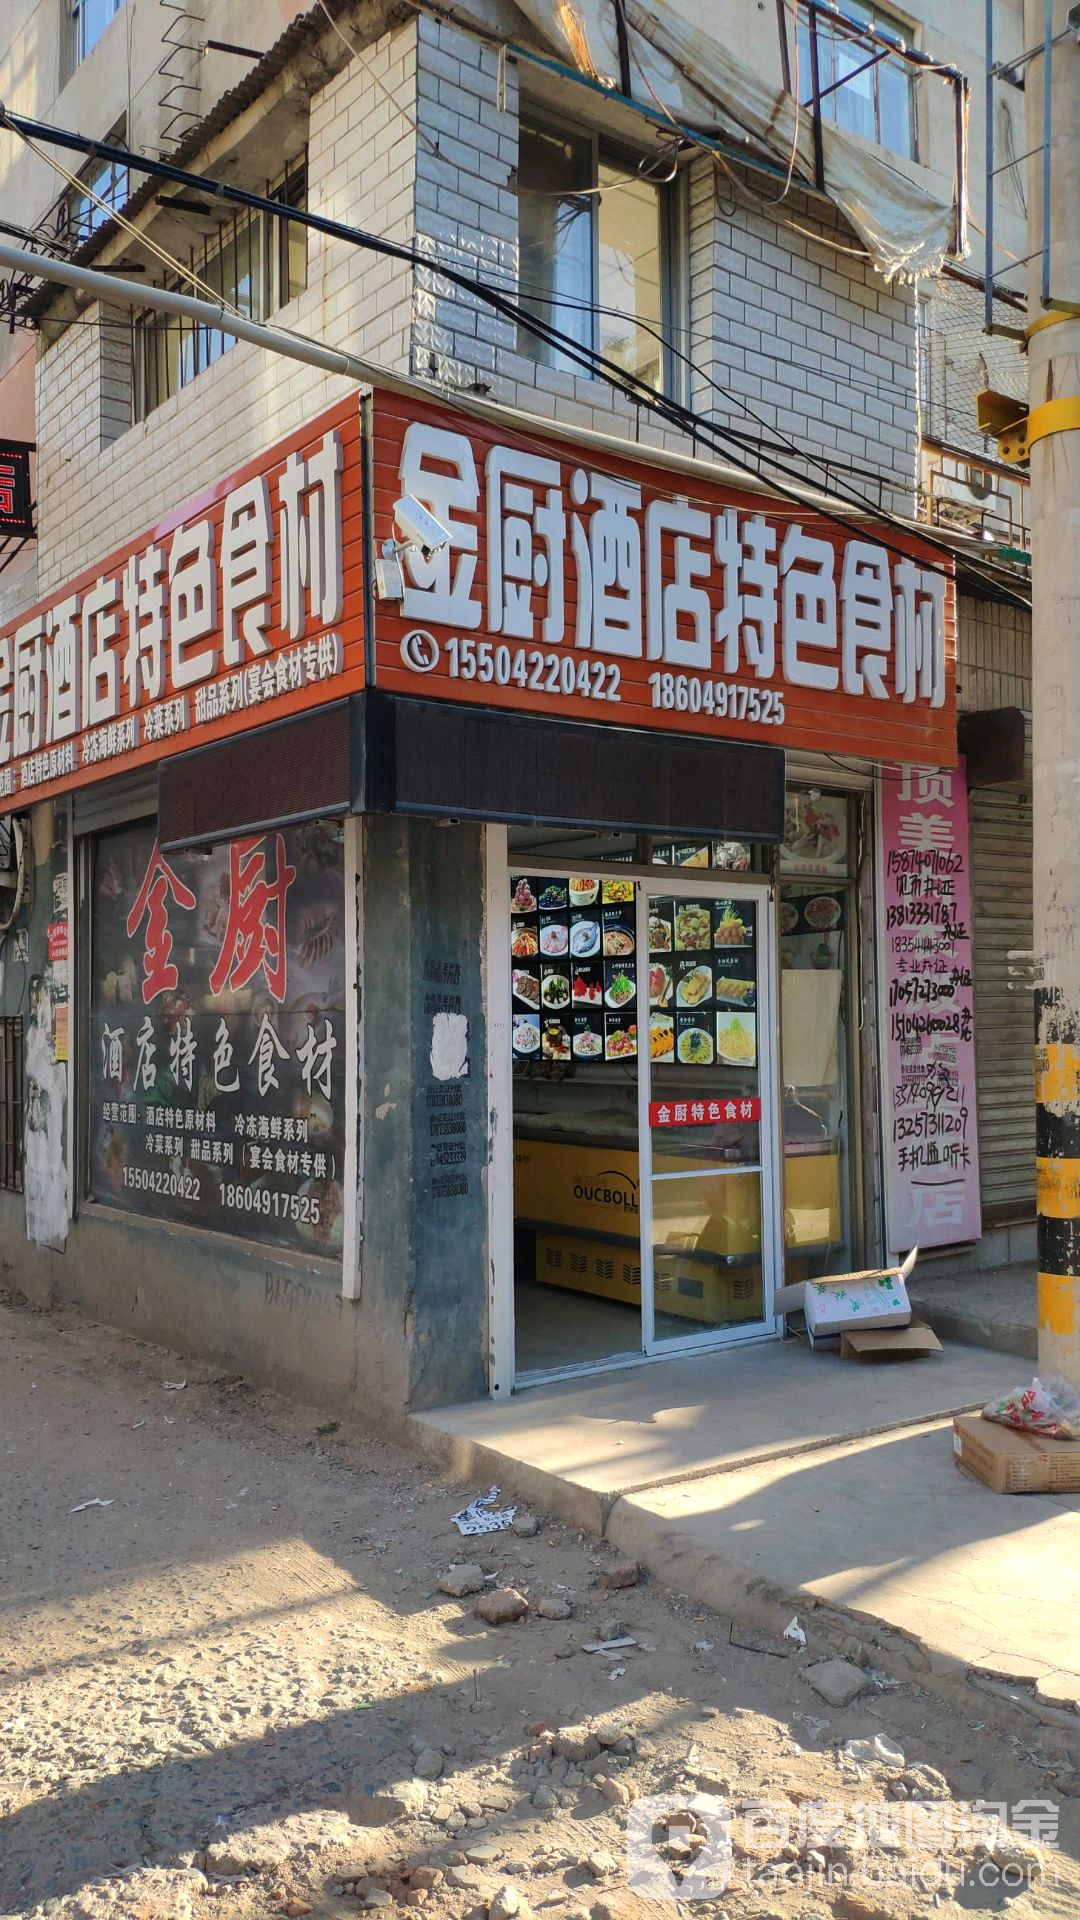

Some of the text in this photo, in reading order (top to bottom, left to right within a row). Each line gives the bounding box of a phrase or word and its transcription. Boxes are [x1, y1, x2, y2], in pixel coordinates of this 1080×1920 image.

[397, 421, 946, 709] 金厨酒店特色食材
[444, 637, 786, 726] 15504220422 18604917525
[144, 694, 187, 741] 冷菜系列
[126, 833, 297, 1004] 金厨
[101, 1013, 338, 1100] 酒店特色食材
[234, 1113, 309, 1143] 冷冻海鲜系列
[656, 1100, 754, 1124] 金厨特色食材
[145, 1131, 184, 1158] 冷菜系列
[190, 1137, 235, 1166] 甜品系列
[897, 1142, 971, 1173] 手机监听卡
[123, 1165, 321, 1225] 15504220422 18604917525
